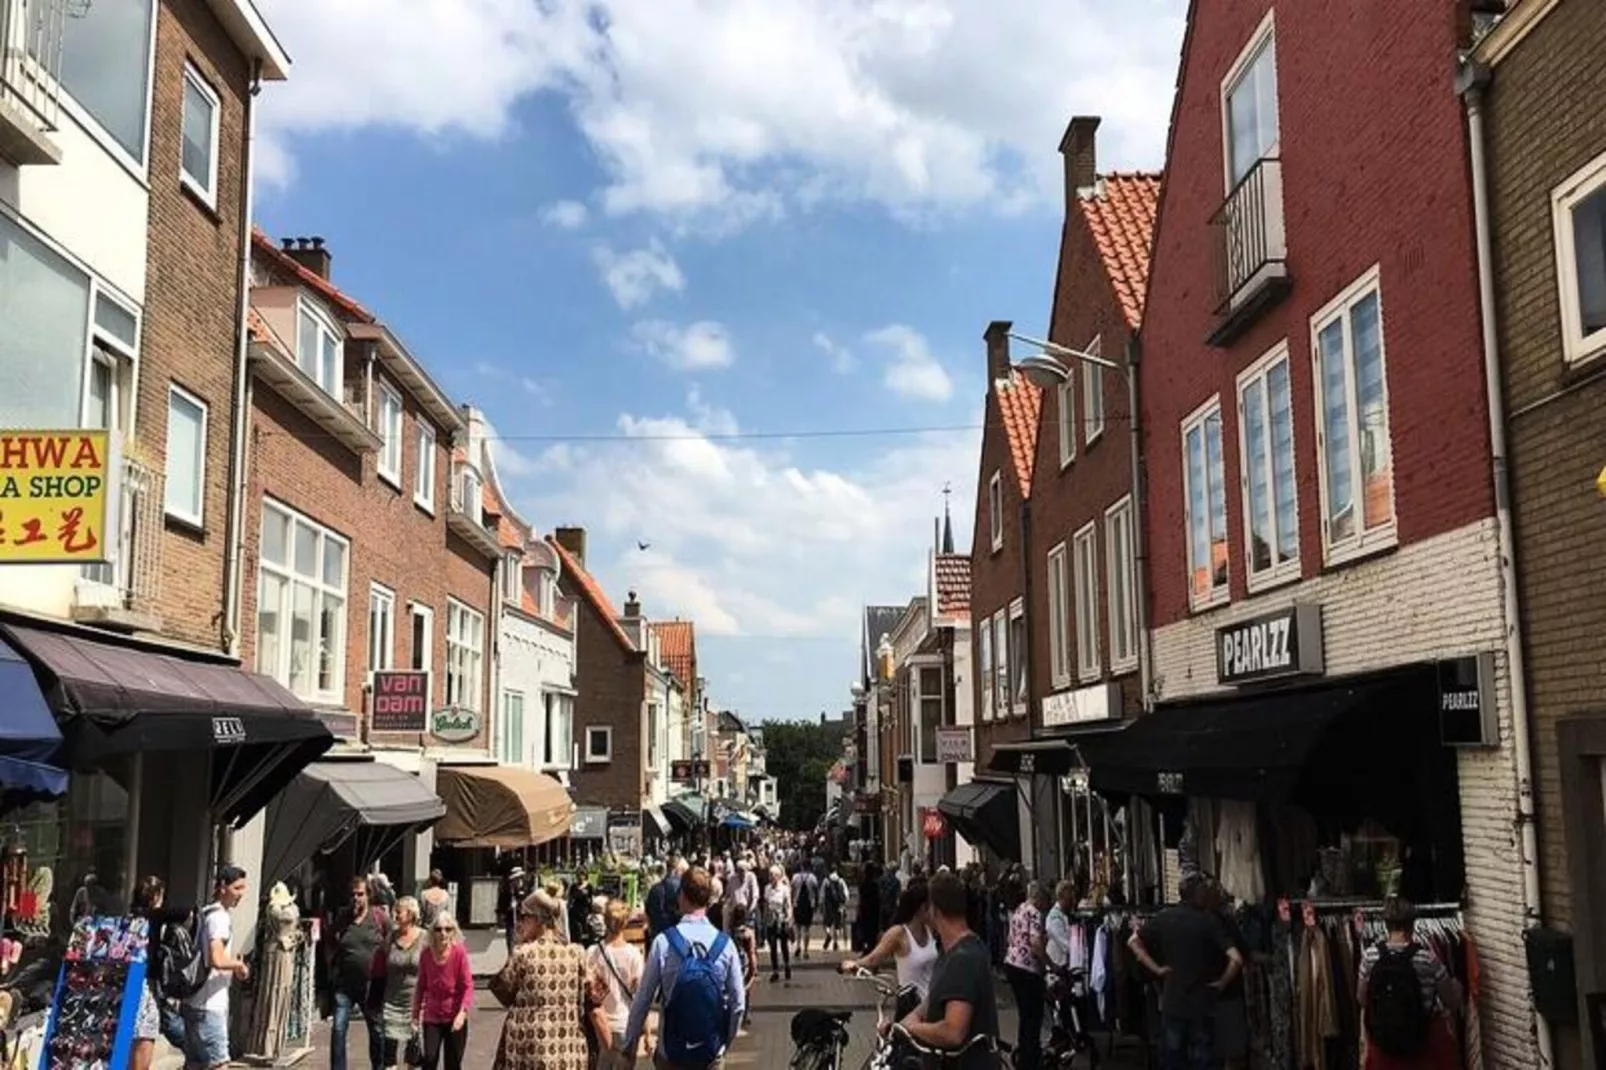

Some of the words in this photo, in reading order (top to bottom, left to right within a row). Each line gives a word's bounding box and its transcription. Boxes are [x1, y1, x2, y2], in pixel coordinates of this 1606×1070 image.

[0, 436, 102, 469] HWA
[29, 475, 102, 498] SHOP
[1223, 617, 1291, 677] PEARLZZ
[381, 675, 422, 692] van
[1442, 690, 1479, 710] PEARLZZ
